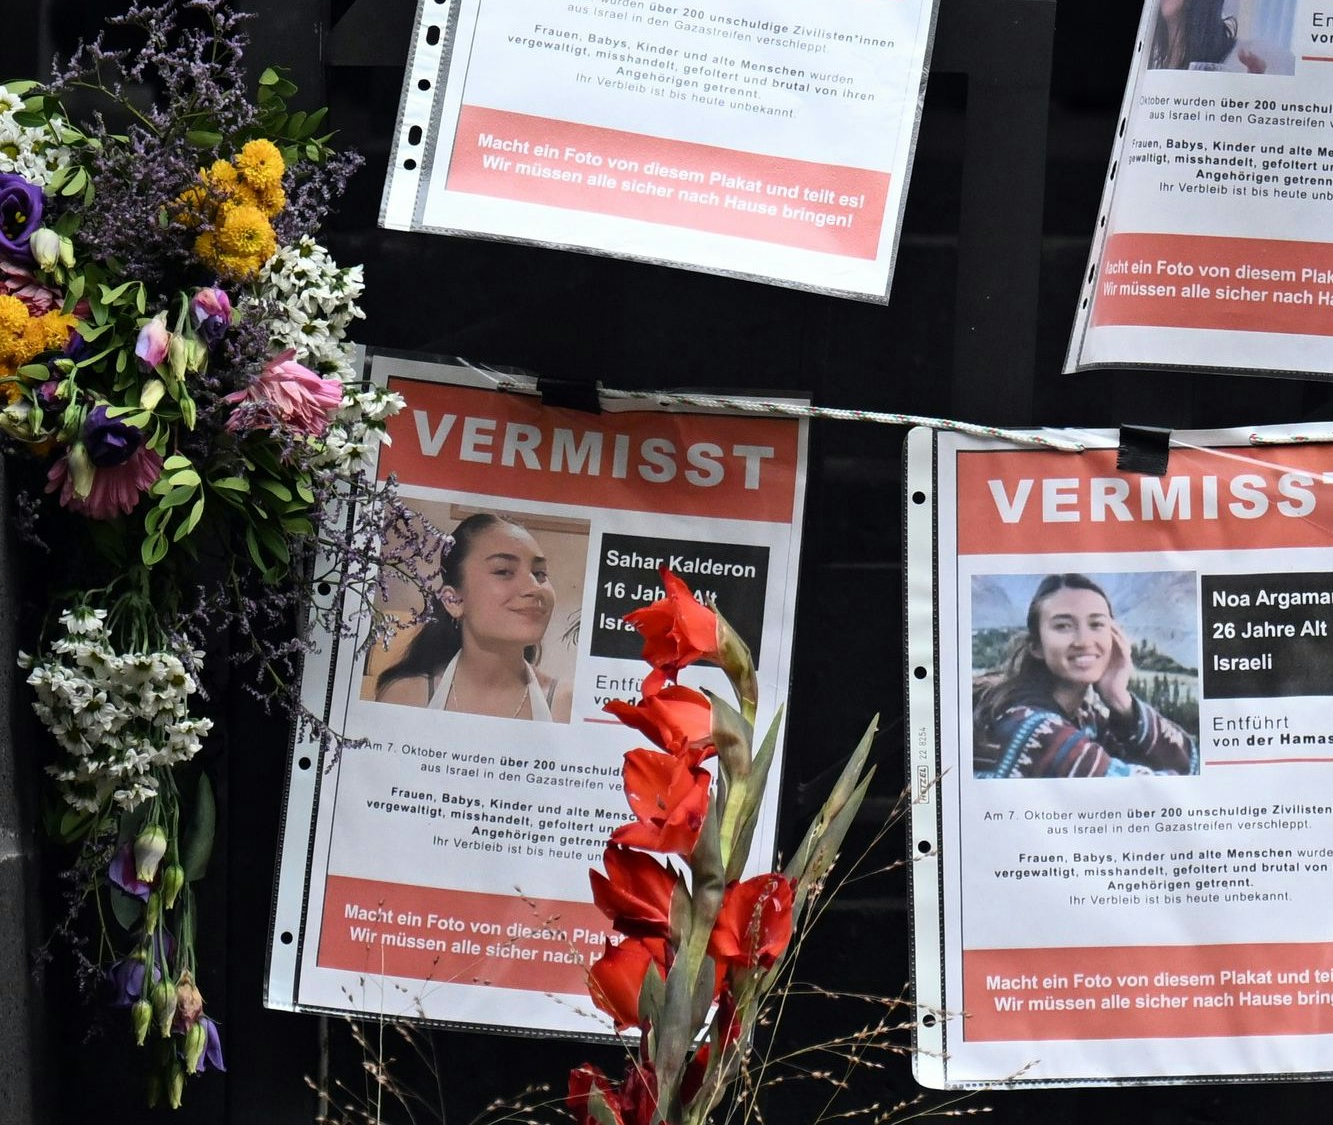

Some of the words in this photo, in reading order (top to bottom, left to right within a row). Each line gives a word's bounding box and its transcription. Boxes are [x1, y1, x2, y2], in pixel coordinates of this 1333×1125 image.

[1194, 168, 1279, 185] Angehörigen
[482, 153, 512, 172] Wir
[514, 161, 583, 183] müssen
[585, 172, 617, 189] alle
[620, 178, 674, 198] sicher
[677, 189, 719, 206] nach
[723, 193, 778, 216] Hause
[781, 203, 853, 228] bringen!
[412, 411, 774, 489] VERMISST
[605, 548, 664, 570] Sahar
[667, 554, 756, 578] Kalderon
[603, 580, 626, 599] 16
[629, 583, 669, 605] Jah
[1211, 589, 1251, 608] Noa
[598, 611, 636, 632] Isra
[1211, 621, 1236, 639] 26
[1240, 620, 1296, 639] Jahre
[1298, 619, 1328, 637] Alt
[1212, 652, 1273, 671] Israeli
[1212, 714, 1289, 732] Entführt
[1211, 736, 1240, 747] von
[1245, 733, 1274, 746] der
[1017, 852, 1068, 863] Frauen,
[1072, 851, 1117, 865] Babys,
[1121, 850, 1165, 862] Kinder
[1169, 849, 1194, 861] und
[1197, 848, 1222, 860] alte
[1226, 847, 1292, 859] Menschen
